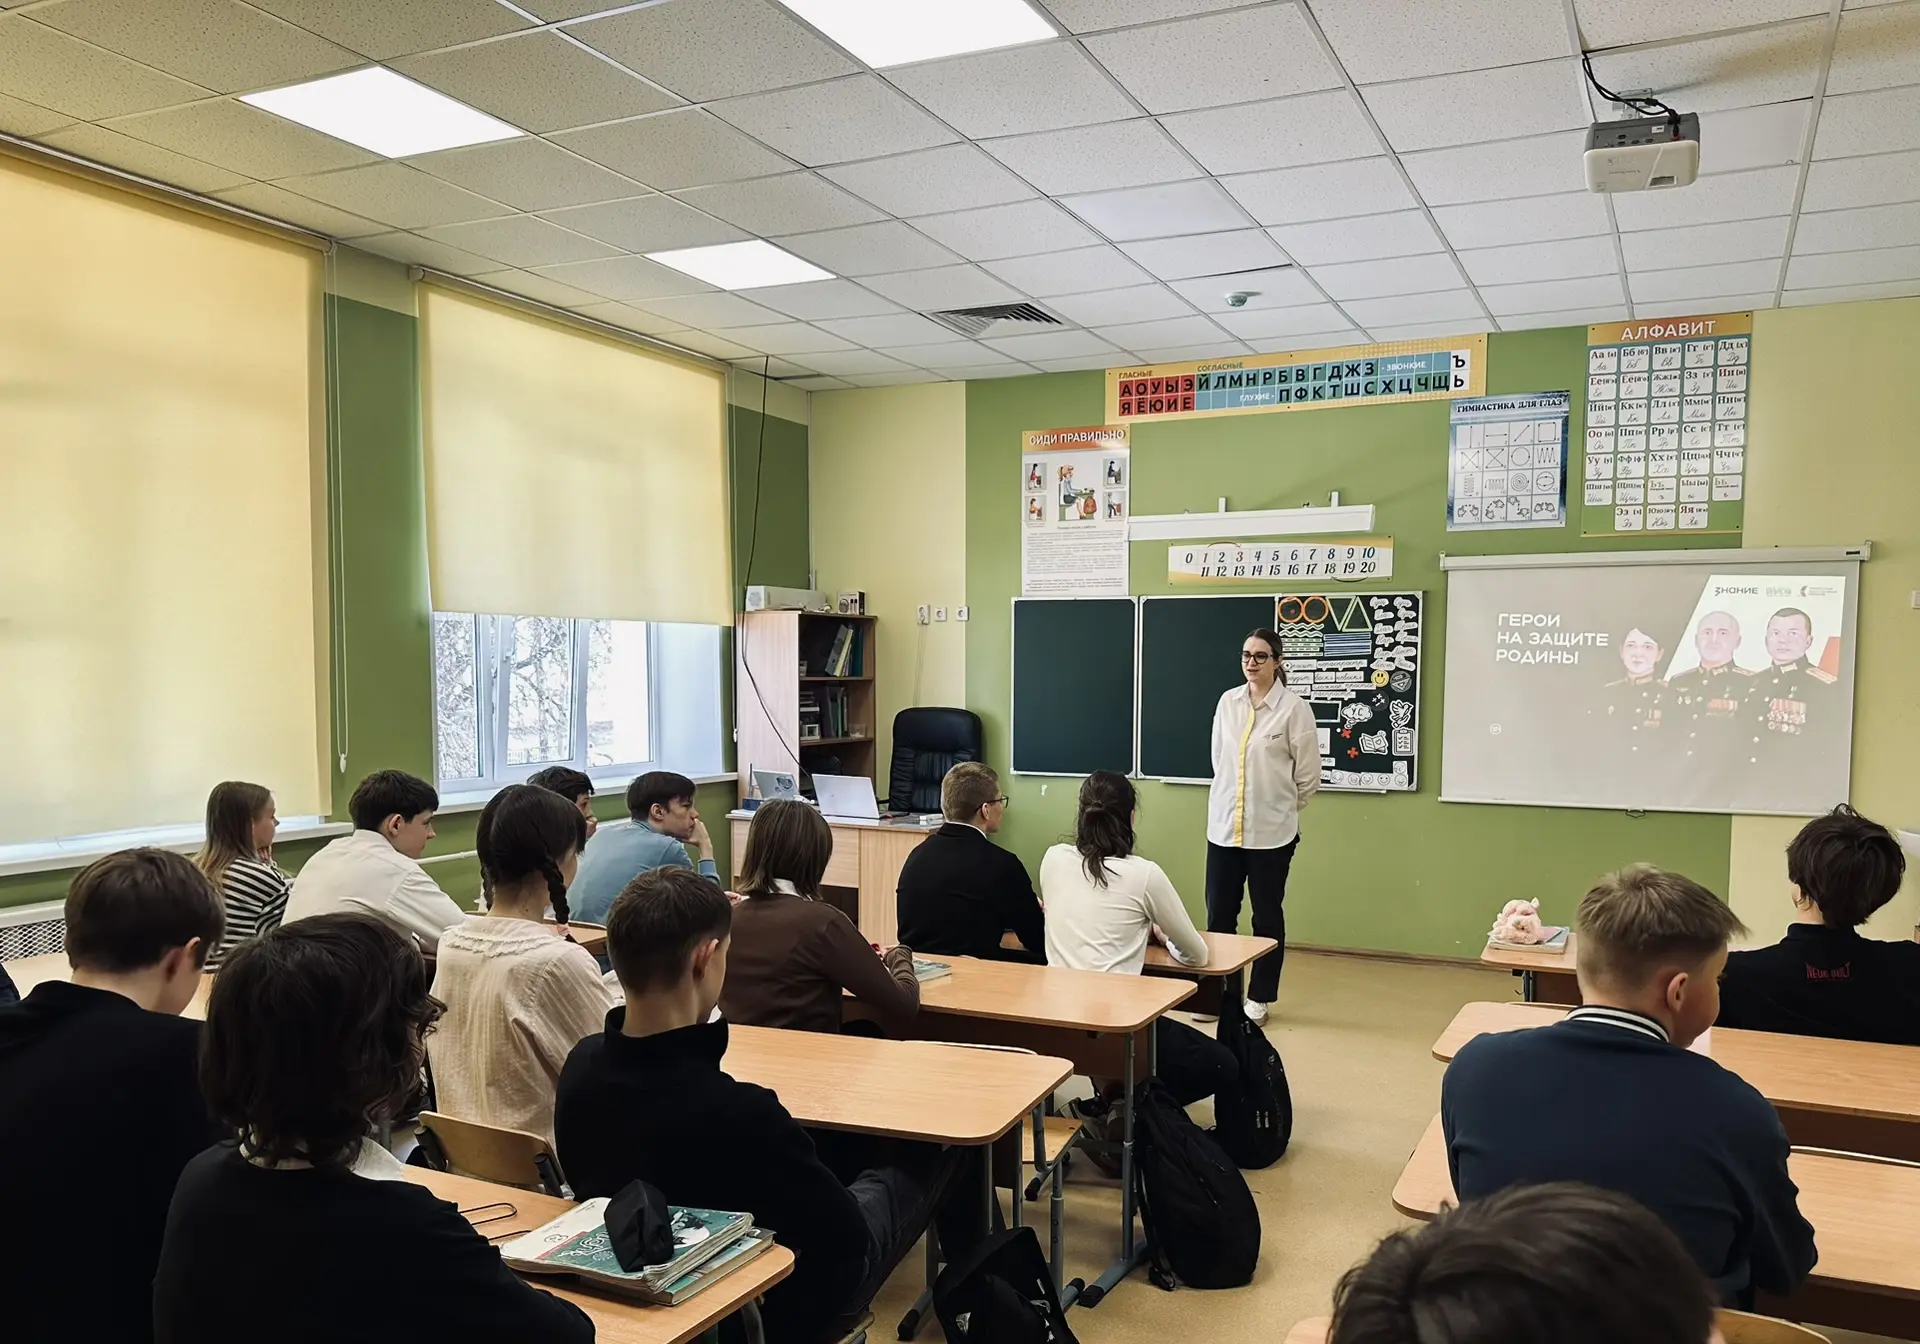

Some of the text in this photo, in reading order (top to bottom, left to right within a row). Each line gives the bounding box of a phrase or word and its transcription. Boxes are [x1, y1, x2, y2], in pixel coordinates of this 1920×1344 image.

[1621, 321, 1716, 340] АЛФАВИТ
[1118, 362, 1244, 379] ГЛАСНЫЕ СОГЛАСНЫЕ
[1386, 361, 1426, 371] ЗВОНКИЕ
[1239, 393, 1270, 402] ГЛУХИЕ
[1457, 402, 1515, 413] ГИМНАСТИКА
[1539, 399, 1562, 407] ГЛАЗ
[1029, 429, 1125, 446] СИДИ ПРАВИЛЬНО
[1185, 547, 1376, 563] 0 1 2 3 4 5 6 7 8 9 10
[1201, 562, 1376, 577] 11 12 13 14 15 16 17 18 19 20
[1498, 613, 1561, 627] ГЕРОИ
[1497, 631, 1609, 648] НА ЗАЩИТЕ
[1496, 649, 1580, 664] РОДИНЫ
